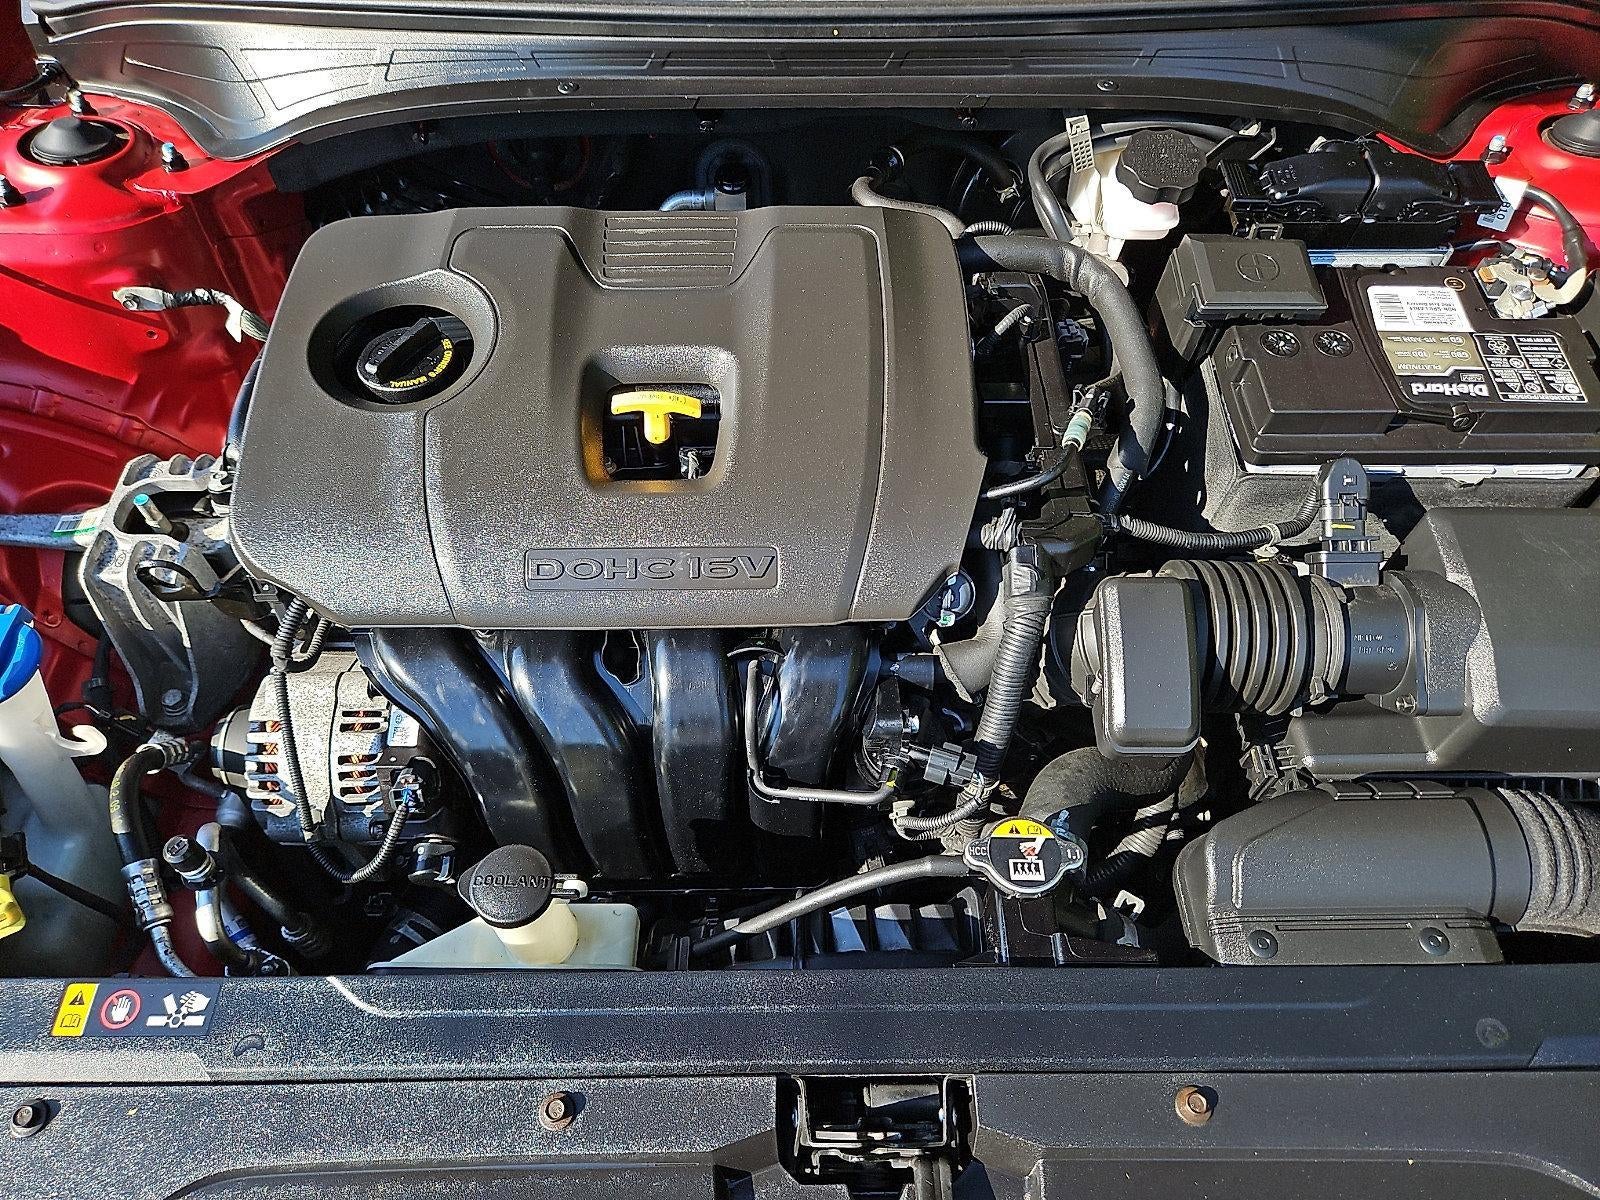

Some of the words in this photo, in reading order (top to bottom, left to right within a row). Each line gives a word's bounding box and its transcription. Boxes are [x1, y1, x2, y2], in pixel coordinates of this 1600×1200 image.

[389, 375, 428, 388] MANUAL
[1410, 382, 1490, 397] DieHard
[529, 557, 675, 581] DOHC
[687, 555, 776, 580] 16V
[968, 846, 987, 856] HCC
[1066, 848, 1081, 860] 1.1
[473, 875, 551, 889] COOLANT
